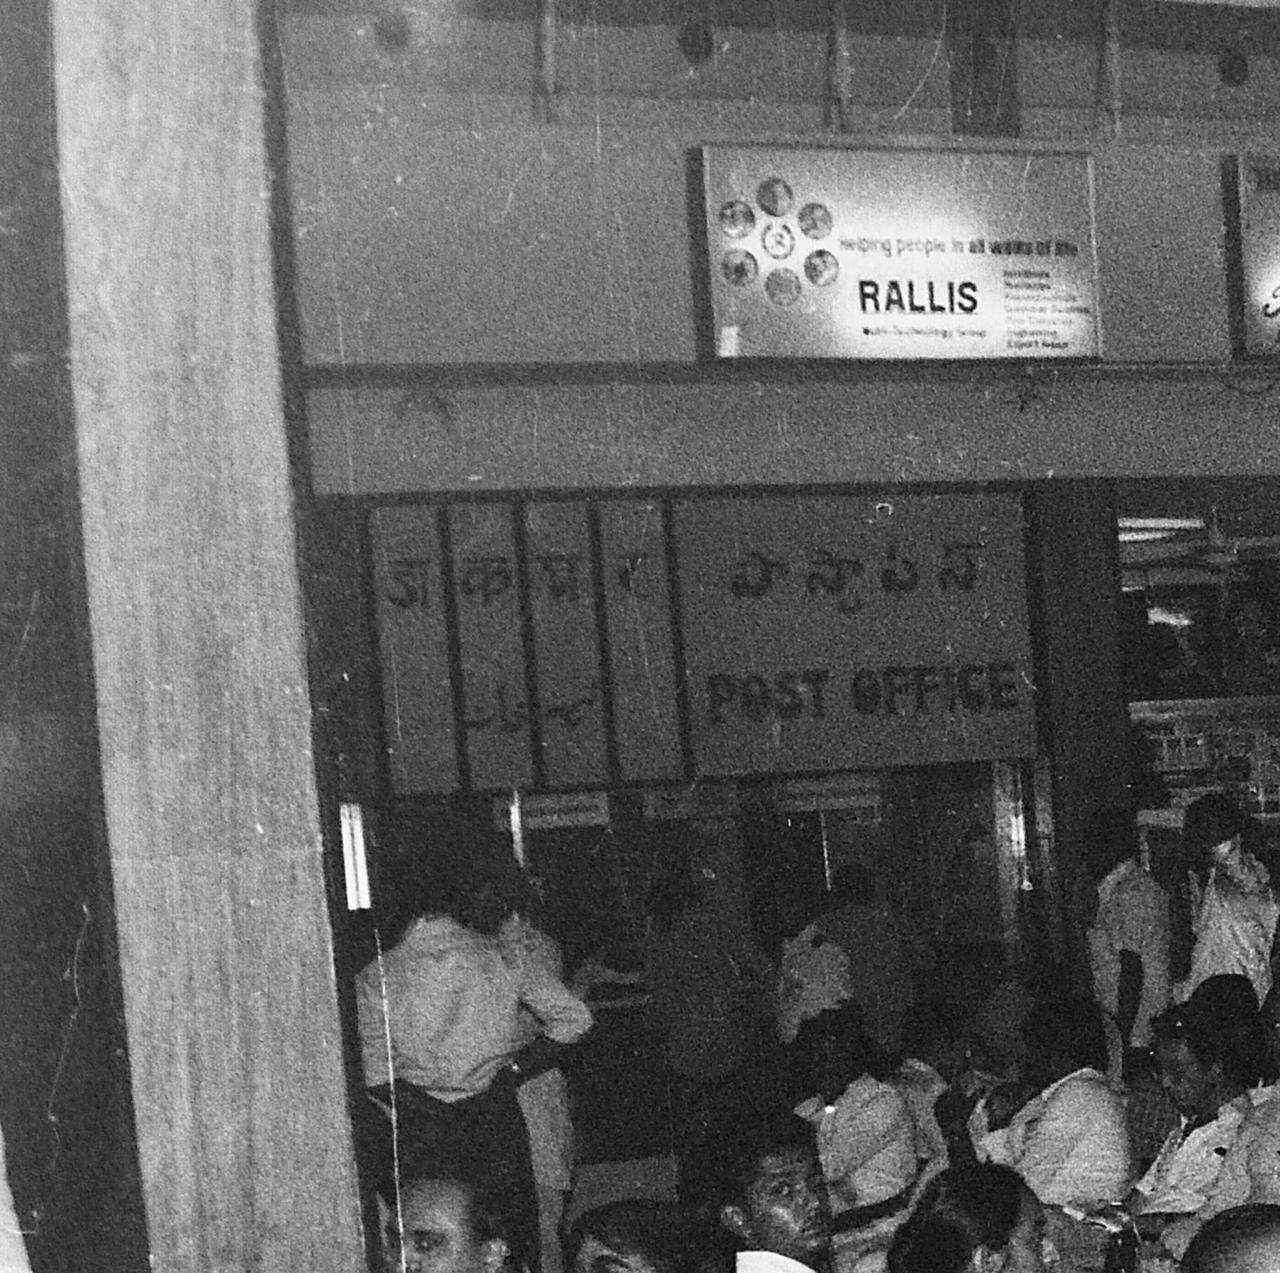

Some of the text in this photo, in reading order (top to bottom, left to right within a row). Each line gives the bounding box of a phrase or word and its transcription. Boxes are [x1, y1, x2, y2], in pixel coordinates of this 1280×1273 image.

[859, 279, 979, 314] RALLIS
[707, 663, 1020, 725] POST OFFICE
